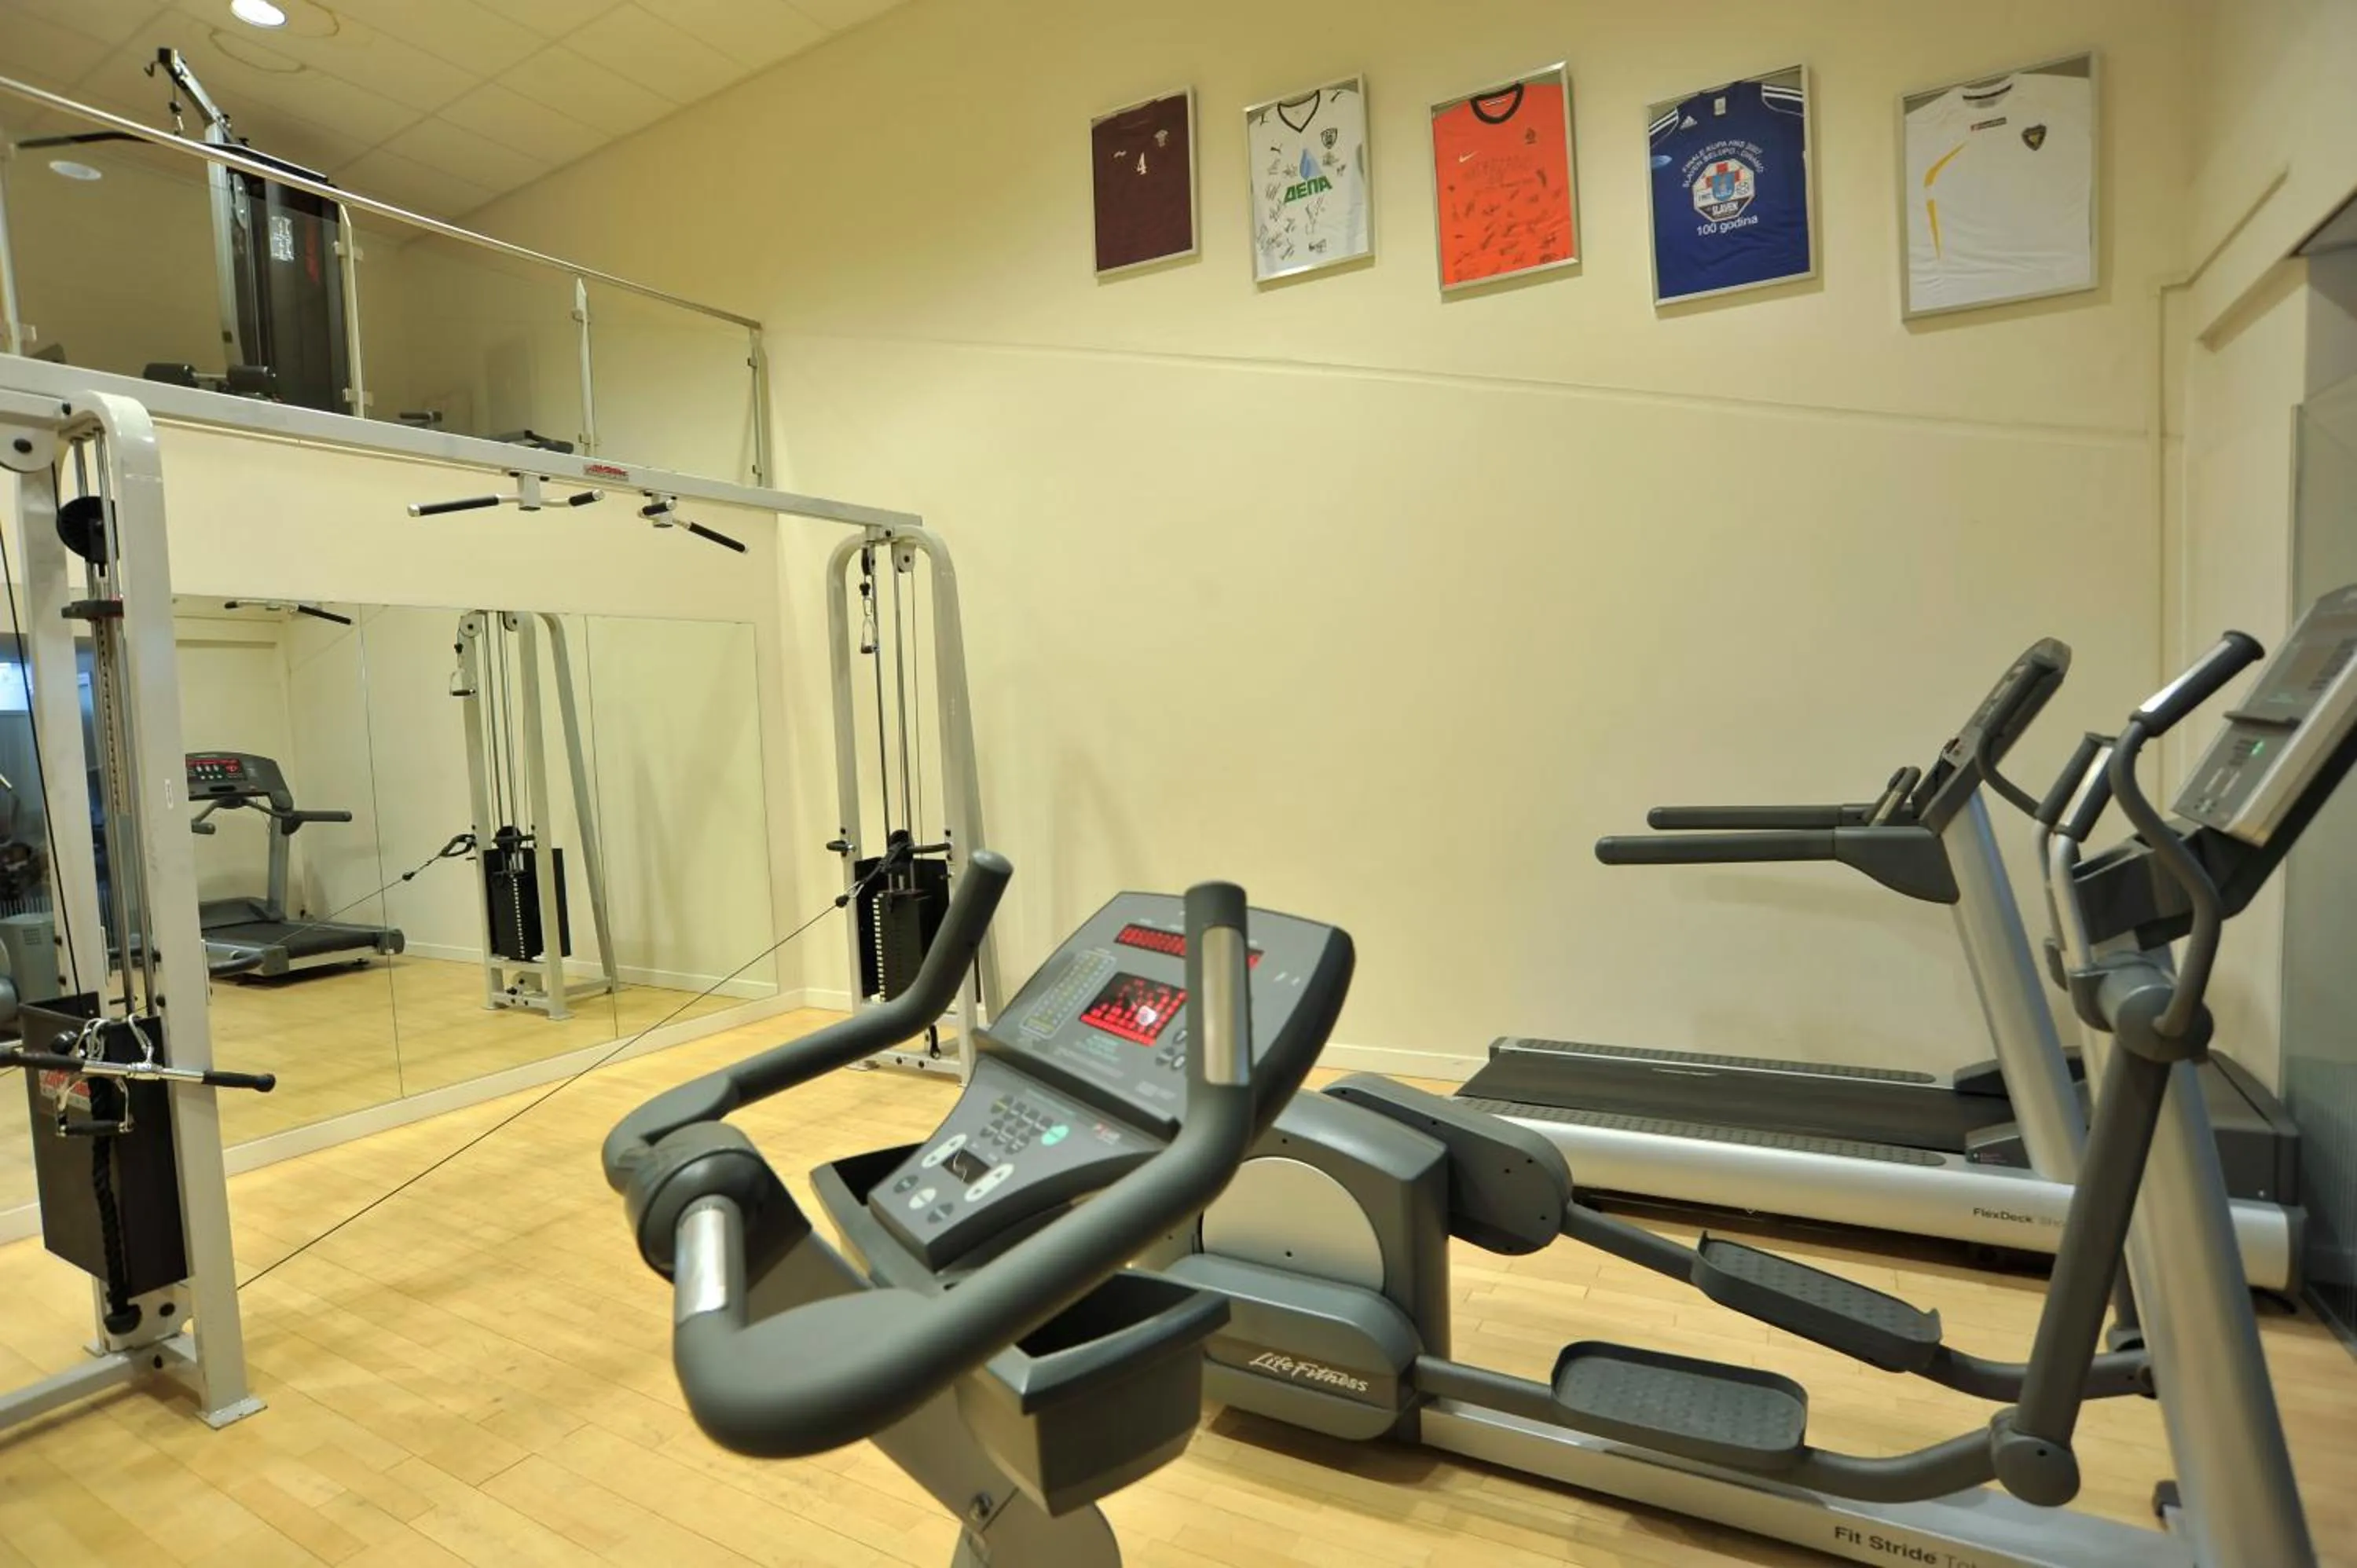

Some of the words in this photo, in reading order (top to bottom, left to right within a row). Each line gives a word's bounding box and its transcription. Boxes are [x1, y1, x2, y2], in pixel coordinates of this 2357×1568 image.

[1136, 152, 1147, 176] 4
[1697, 223, 1717, 236] 100
[1720, 215, 1758, 233] godina
[1972, 1207, 2034, 1224] FlexDeck
[1834, 1526, 1863, 1545] Fit
[1868, 1534, 1937, 1566] Stride
